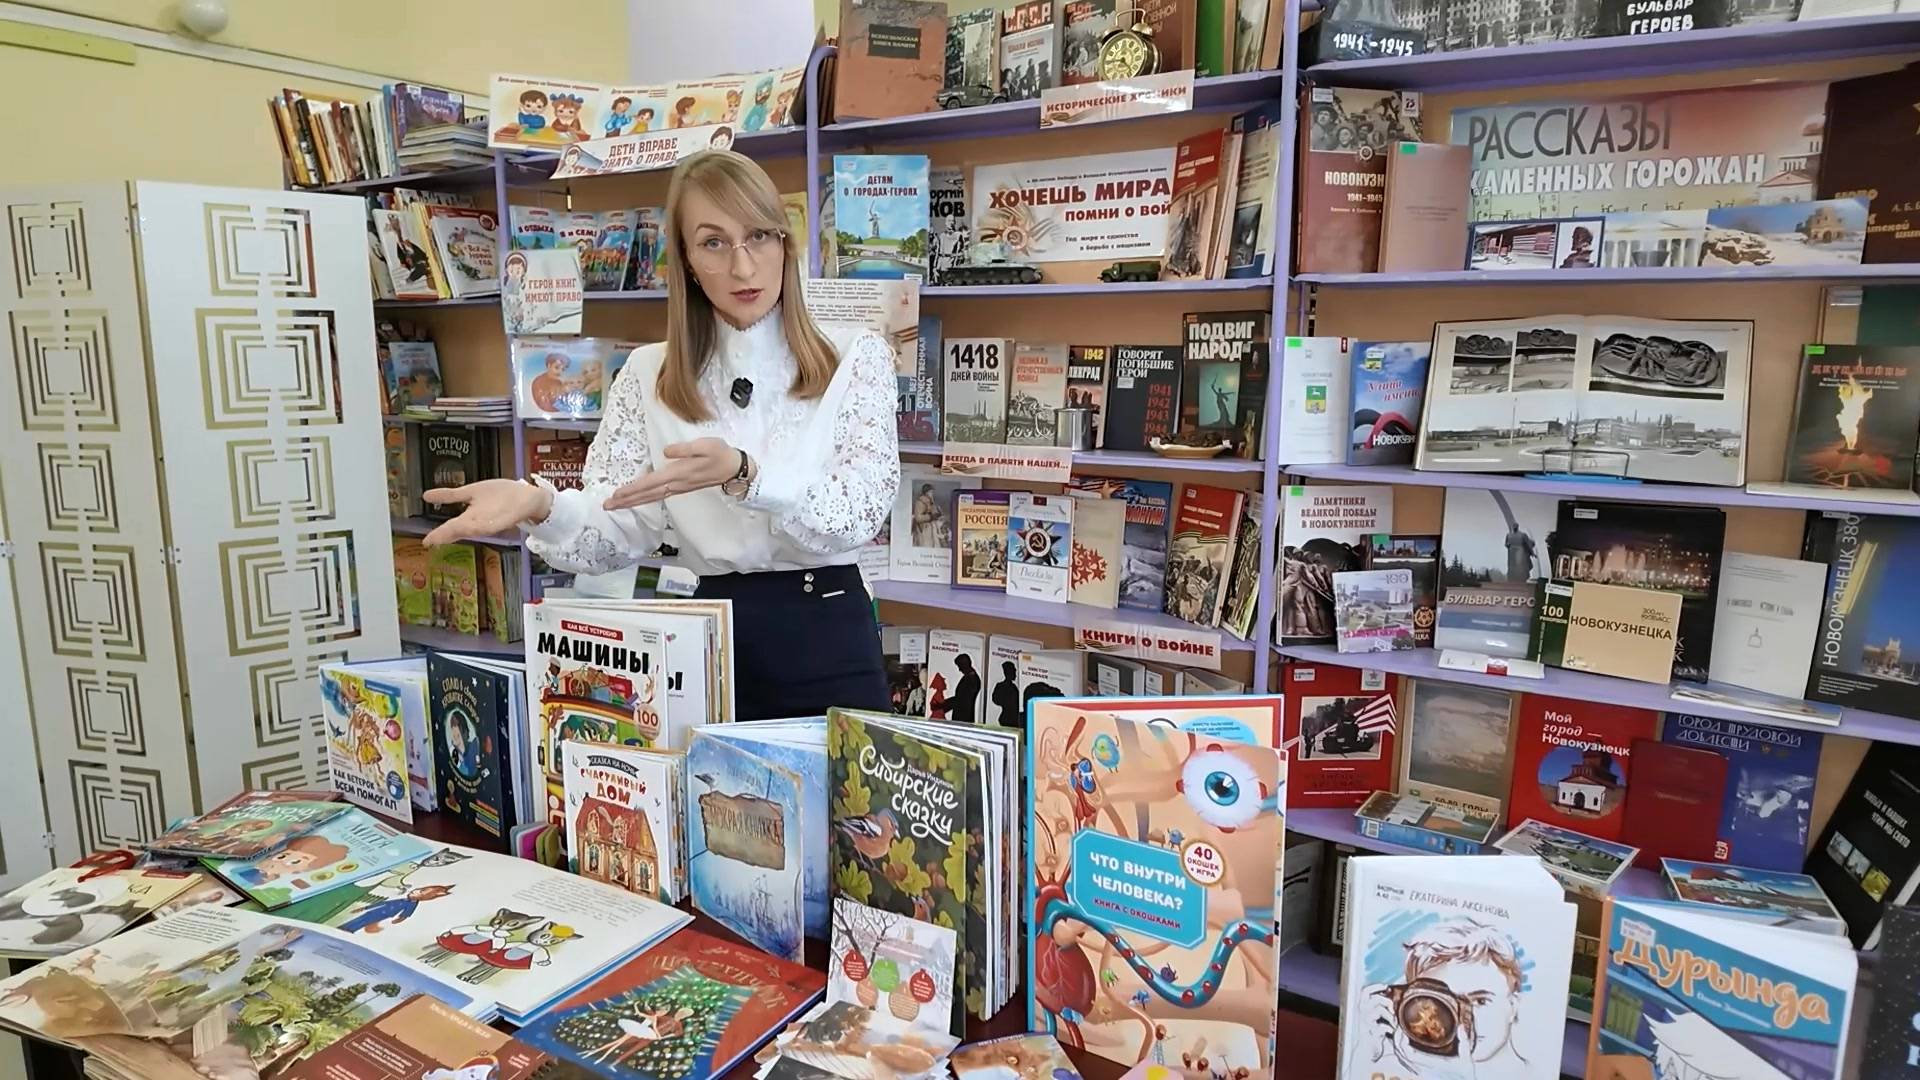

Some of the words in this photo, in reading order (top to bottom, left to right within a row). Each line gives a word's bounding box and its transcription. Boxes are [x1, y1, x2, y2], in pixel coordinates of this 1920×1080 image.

[1631, 16, 1694, 35] ГЕРОЕВ
[1046, 95, 1127, 113] ИСТОРИЧЕСКИЕ
[1468, 103, 1671, 160] РАССКАЗЫ
[608, 142, 636, 158] ДЕТИ
[639, 137, 678, 154] ВПРАВЕ
[601, 155, 634, 169] ЗНАТЬ
[636, 155, 644, 165] О
[645, 150, 679, 164] ПРАВЕ
[1624, 152, 1766, 189] ГОРОЖАН
[867, 176, 893, 185] ДЕТЯМ
[844, 188, 849, 196] О
[989, 186, 1087, 209] ХОЧЕШЬ
[1095, 178, 1171, 201] МИРА
[1065, 208, 1119, 222] ПОМНИ
[1125, 207, 1134, 217] О
[529, 279, 554, 288] ГЕРОИ
[555, 279, 576, 288] КНИГ
[525, 291, 555, 303] ИМЕЮТ
[556, 291, 582, 302] ПРАВО
[1189, 321, 1255, 341] ПОДВИГ
[951, 344, 999, 369] 1418
[1083, 349, 1104, 360] 1942
[1118, 350, 1163, 360] ГОВОРЯТ
[1116, 368, 1148, 378] ГЕРОИ
[1117, 359, 1174, 370] ПОГИБШИЕ
[951, 371, 971, 382] ДНЕЙ
[973, 371, 999, 381] ВОЙНЫ
[429, 436, 470, 454] ОСТРОВ
[945, 455, 976, 464] ВСЕГДА
[987, 457, 1024, 467] ПАМЯТИ
[1314, 497, 1366, 505] ПАМЯТНИКИ
[965, 514, 1008, 526] РОССИЯ
[1301, 507, 1340, 517] ВЕЛИКОЙ
[1342, 508, 1377, 517] ПОБЕДЫ
[1310, 519, 1376, 529] НОВОКУЗНЕЦКЕ
[1445, 593, 1501, 606] БУЛЬВАР
[1822, 549, 1855, 666] НОВОКУЗНЕЦК
[1844, 515, 1860, 545] 380
[1541, 605, 1564, 617] 100
[1570, 615, 1673, 640] НОВОКУЗНЕЦКА
[1082, 629, 1135, 645] КНИГИ
[1142, 638, 1152, 647] О
[1158, 639, 1214, 656] ВОЙНЕ
[537, 632, 649, 675] МАШИНЫ
[636, 709, 659, 727] 100
[1544, 711, 1572, 725] Мой
[1543, 724, 1583, 737] город
[1678, 715, 1721, 732] ГОРОД
[1728, 723, 1801, 746] ТРУДОВОЙ
[1542, 733, 1630, 757] Новокузнецк
[1676, 730, 1750, 751] ДОБЛЕСТИ
[591, 756, 611, 767] СКАЗКА
[621, 764, 635, 774] НОЧЬ
[334, 769, 346, 780] КАК
[347, 773, 374, 790] ВЕТЕРОК
[580, 768, 647, 795] СЧАСТЛИВЫЙ
[860, 745, 959, 809] Сибирские
[335, 780, 355, 796] ВСЕМ
[357, 789, 397, 811] ПОМОГАЛ
[597, 782, 631, 805] ДОМ
[892, 793, 953, 846] сказки
[1194, 846, 1212, 860] 40
[1090, 852, 1119, 870] ЧТО
[1123, 861, 1186, 890] ВНУТРИ
[1187, 857, 1219, 871] ОКОШЕК
[1196, 868, 1216, 878] ИГРА
[1092, 873, 1184, 911] ЧЕЛОВЕКА?
[1094, 898, 1121, 911] КНИГА
[1130, 908, 1181, 929] ОКОШКАМИ
[1409, 890, 1459, 908] ЕКАТЕРИНА
[1462, 897, 1510, 919] АКСЕНОВА
[1613, 936, 1831, 1029] Дурында
